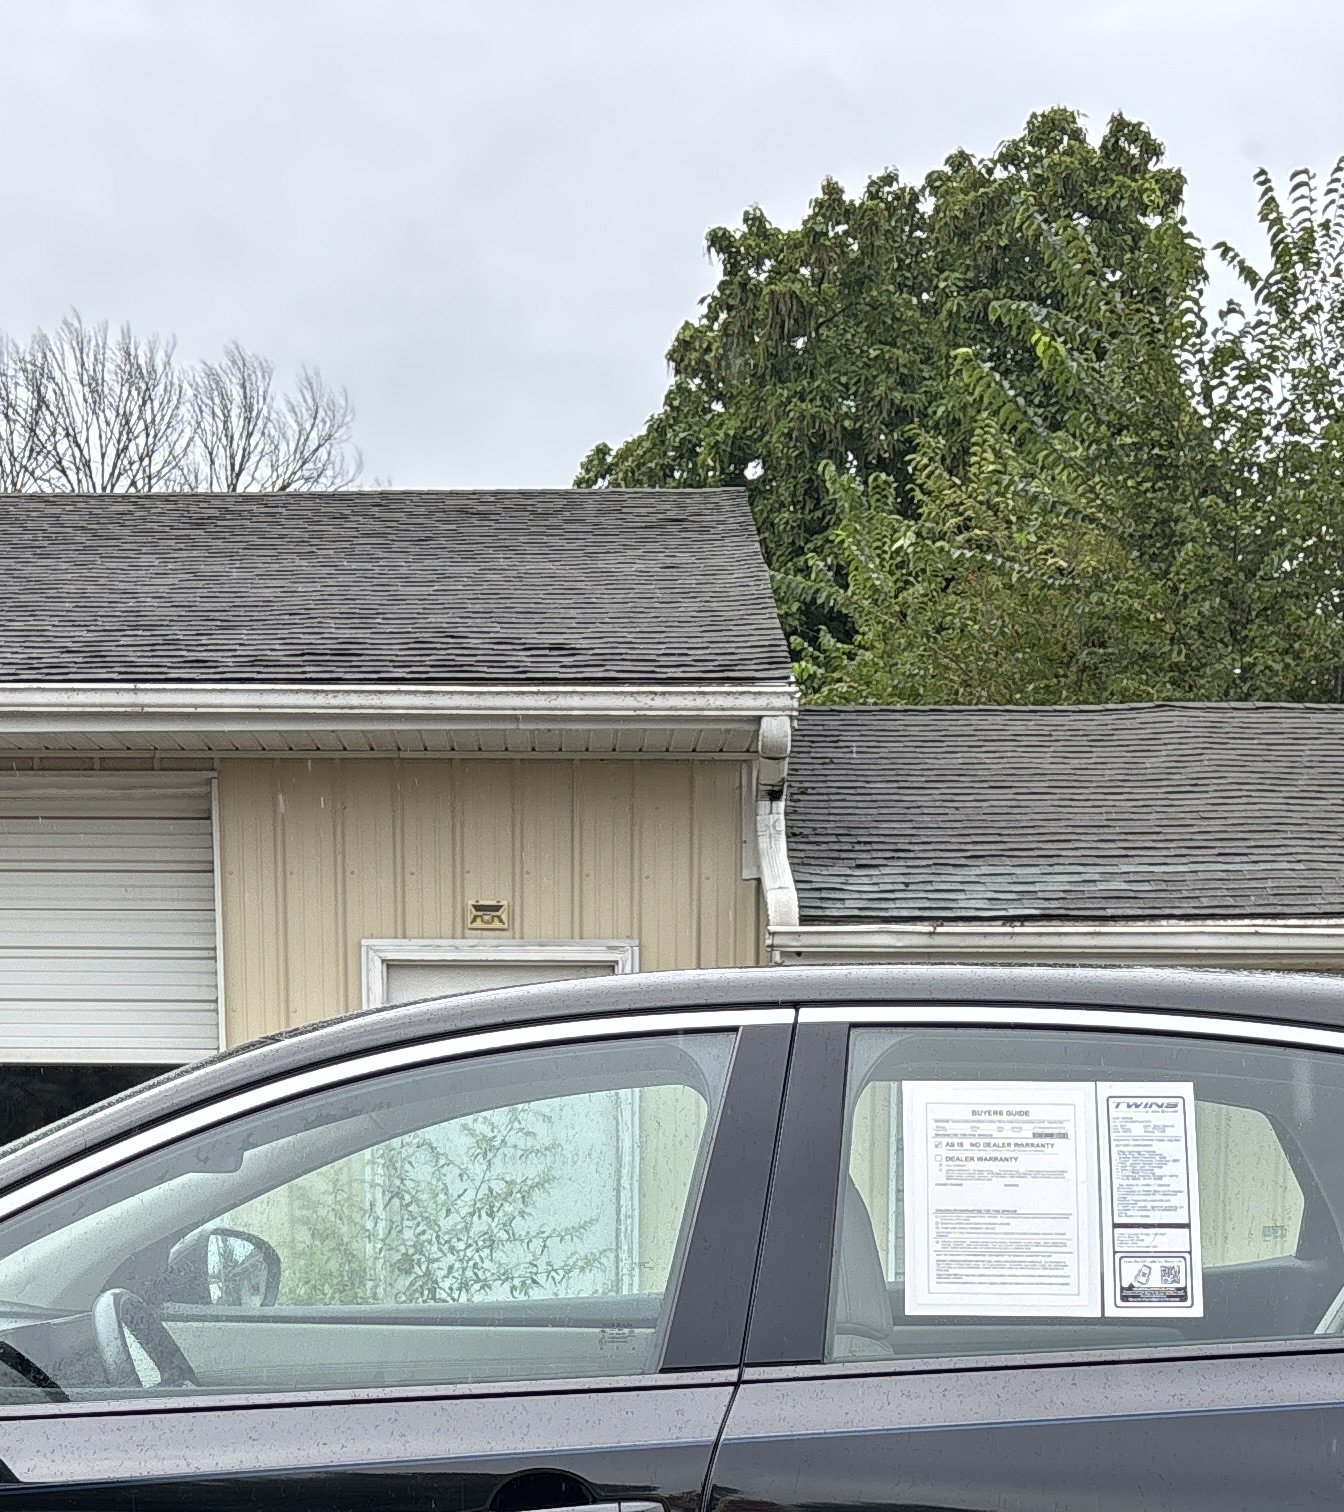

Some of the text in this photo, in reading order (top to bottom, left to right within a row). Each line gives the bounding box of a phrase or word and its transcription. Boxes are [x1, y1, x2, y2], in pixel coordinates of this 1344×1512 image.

[971, 1109, 1031, 1118] BUYERS GUIDE
[944, 1141, 956, 1149] AS
[969, 1141, 981, 1149] NO
[982, 1141, 1012, 1149] DEALER
[1013, 1141, 1056, 1149] WARRANTY
[944, 1155, 1019, 1163] DEALER WARRANTY
